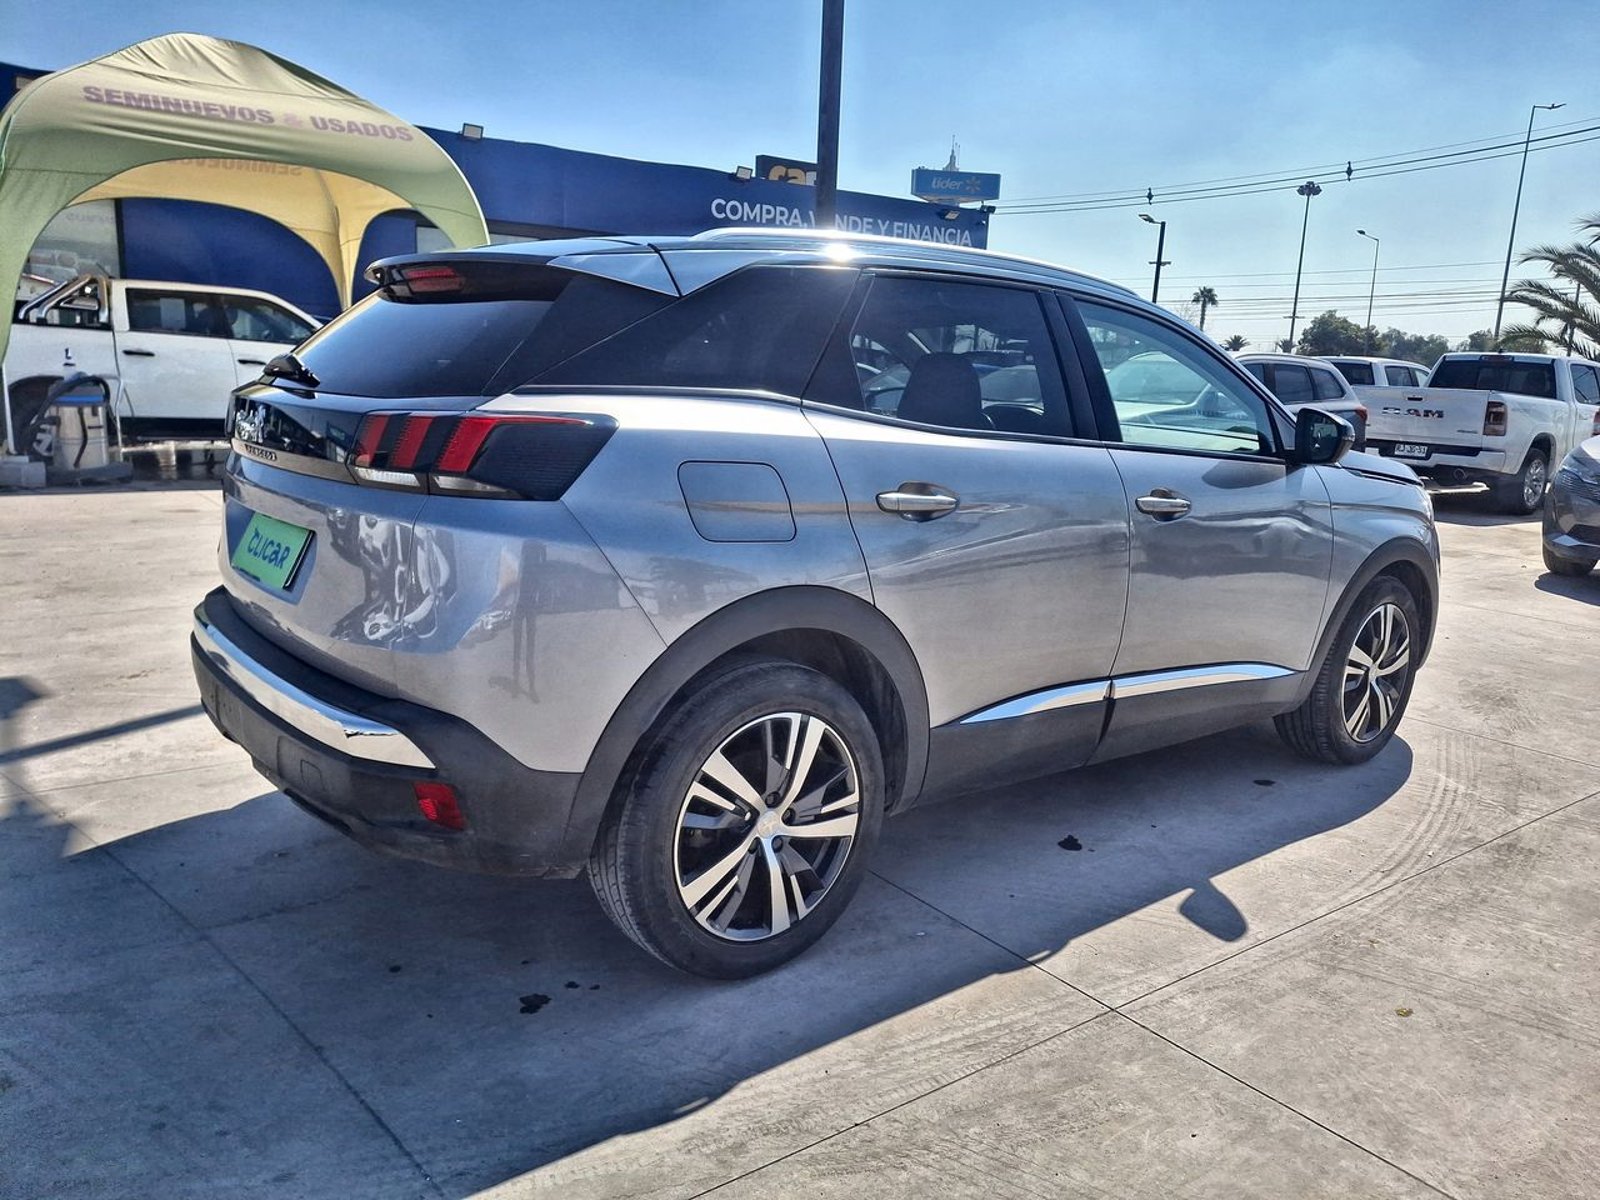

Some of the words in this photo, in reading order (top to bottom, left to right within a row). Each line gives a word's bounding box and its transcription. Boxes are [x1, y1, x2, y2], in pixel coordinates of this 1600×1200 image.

[82, 85, 275, 125] SEMINUEVOS
[310, 116, 414, 141] USADOS
[710, 198, 808, 229] COMPRA,
[877, 219, 890, 236] Y
[893, 222, 973, 247] FINANCIA
